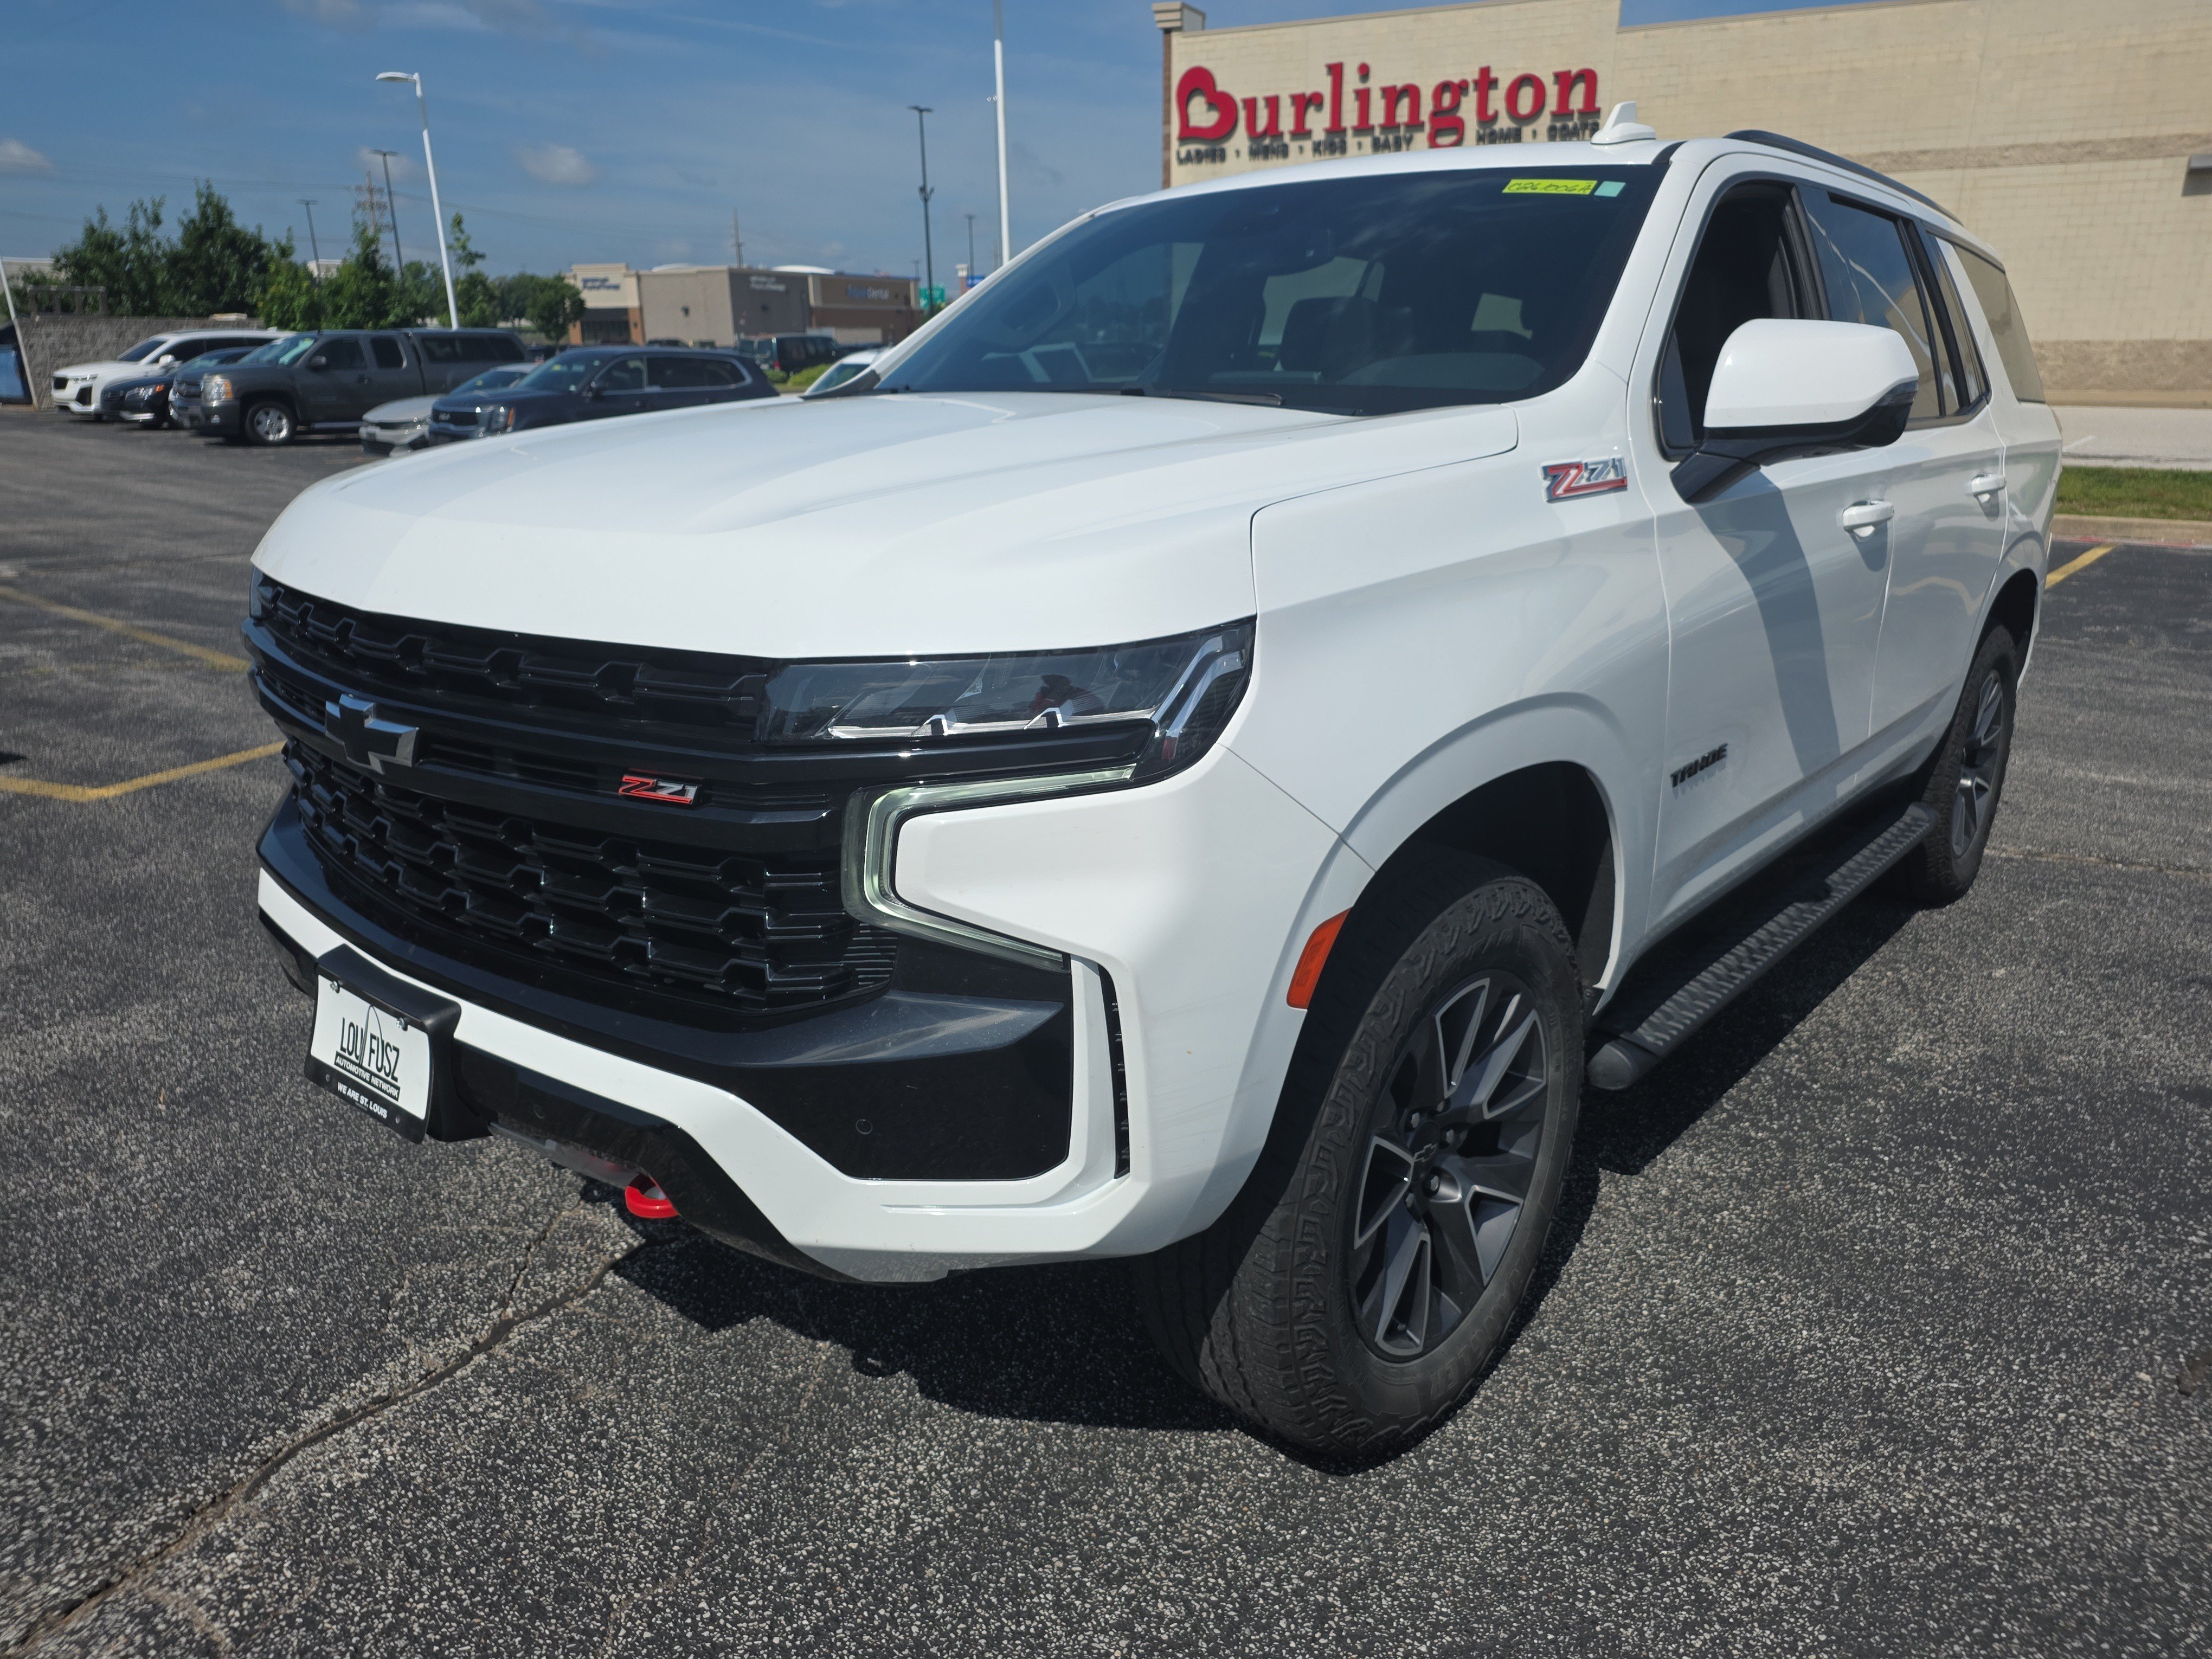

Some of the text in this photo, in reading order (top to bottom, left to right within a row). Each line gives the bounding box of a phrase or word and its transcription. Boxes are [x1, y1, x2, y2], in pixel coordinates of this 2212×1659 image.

[1176, 62, 1602, 149] Burlington
[1541, 458, 1627, 499] Z71
[619, 775, 699, 805] Z71
[340, 1017, 400, 1083] LOU FUSZ
[336, 1056, 399, 1097] AUTOMOTIVE NETWORK
[338, 1082, 387, 1118] WE ARE ST. LOUIS
